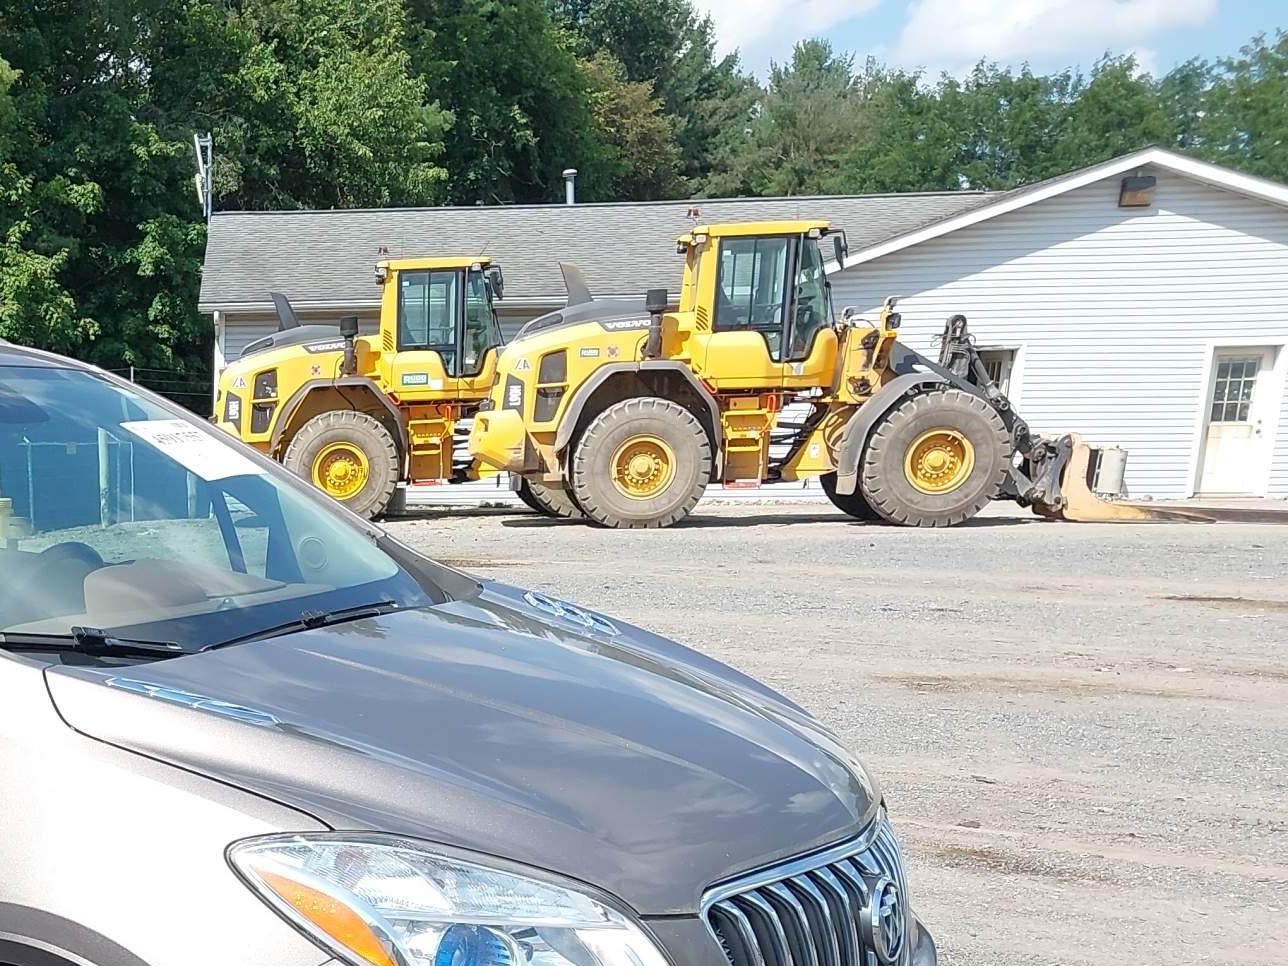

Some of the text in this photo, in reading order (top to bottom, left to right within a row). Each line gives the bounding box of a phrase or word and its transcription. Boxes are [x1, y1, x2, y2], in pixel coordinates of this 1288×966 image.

[604, 319, 652, 331] VOLVO
[508, 385, 522, 406] L90H
[228, 400, 240, 420] L90H
